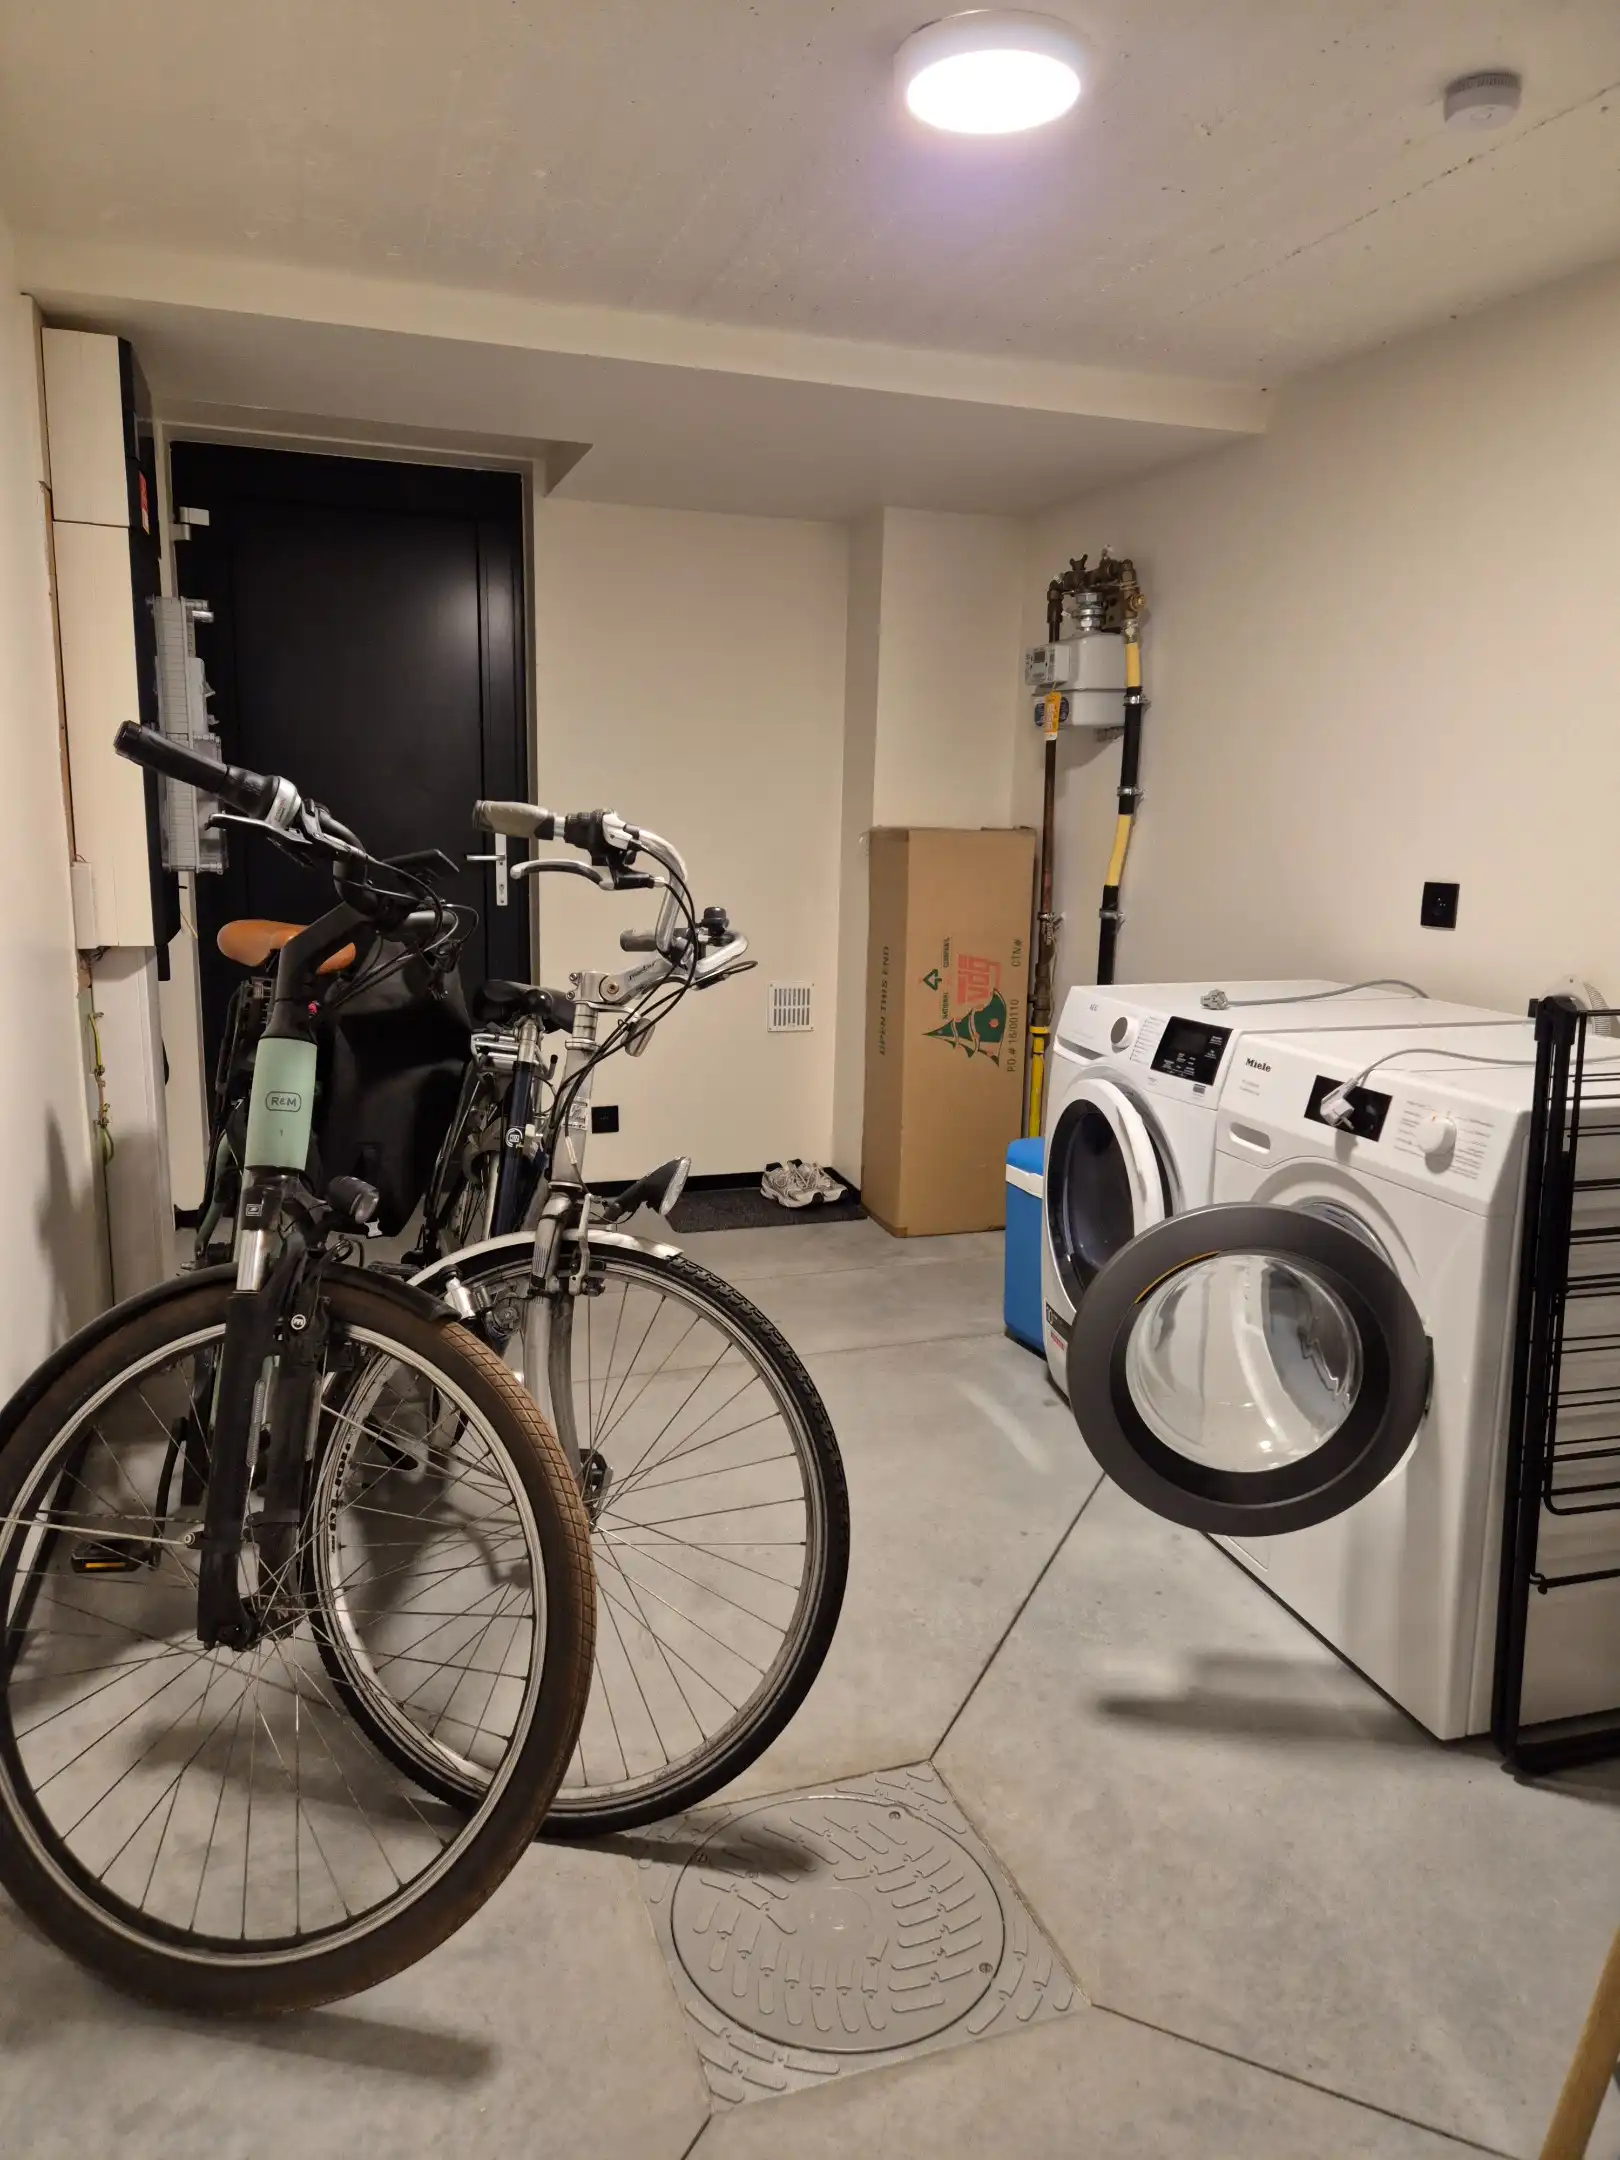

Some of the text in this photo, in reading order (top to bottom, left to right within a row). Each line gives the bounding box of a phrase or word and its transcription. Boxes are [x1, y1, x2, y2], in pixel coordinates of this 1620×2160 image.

[881, 945, 890, 975] END
[880, 980, 889, 1013] THIS
[1245, 1057, 1272, 1073] Miele
